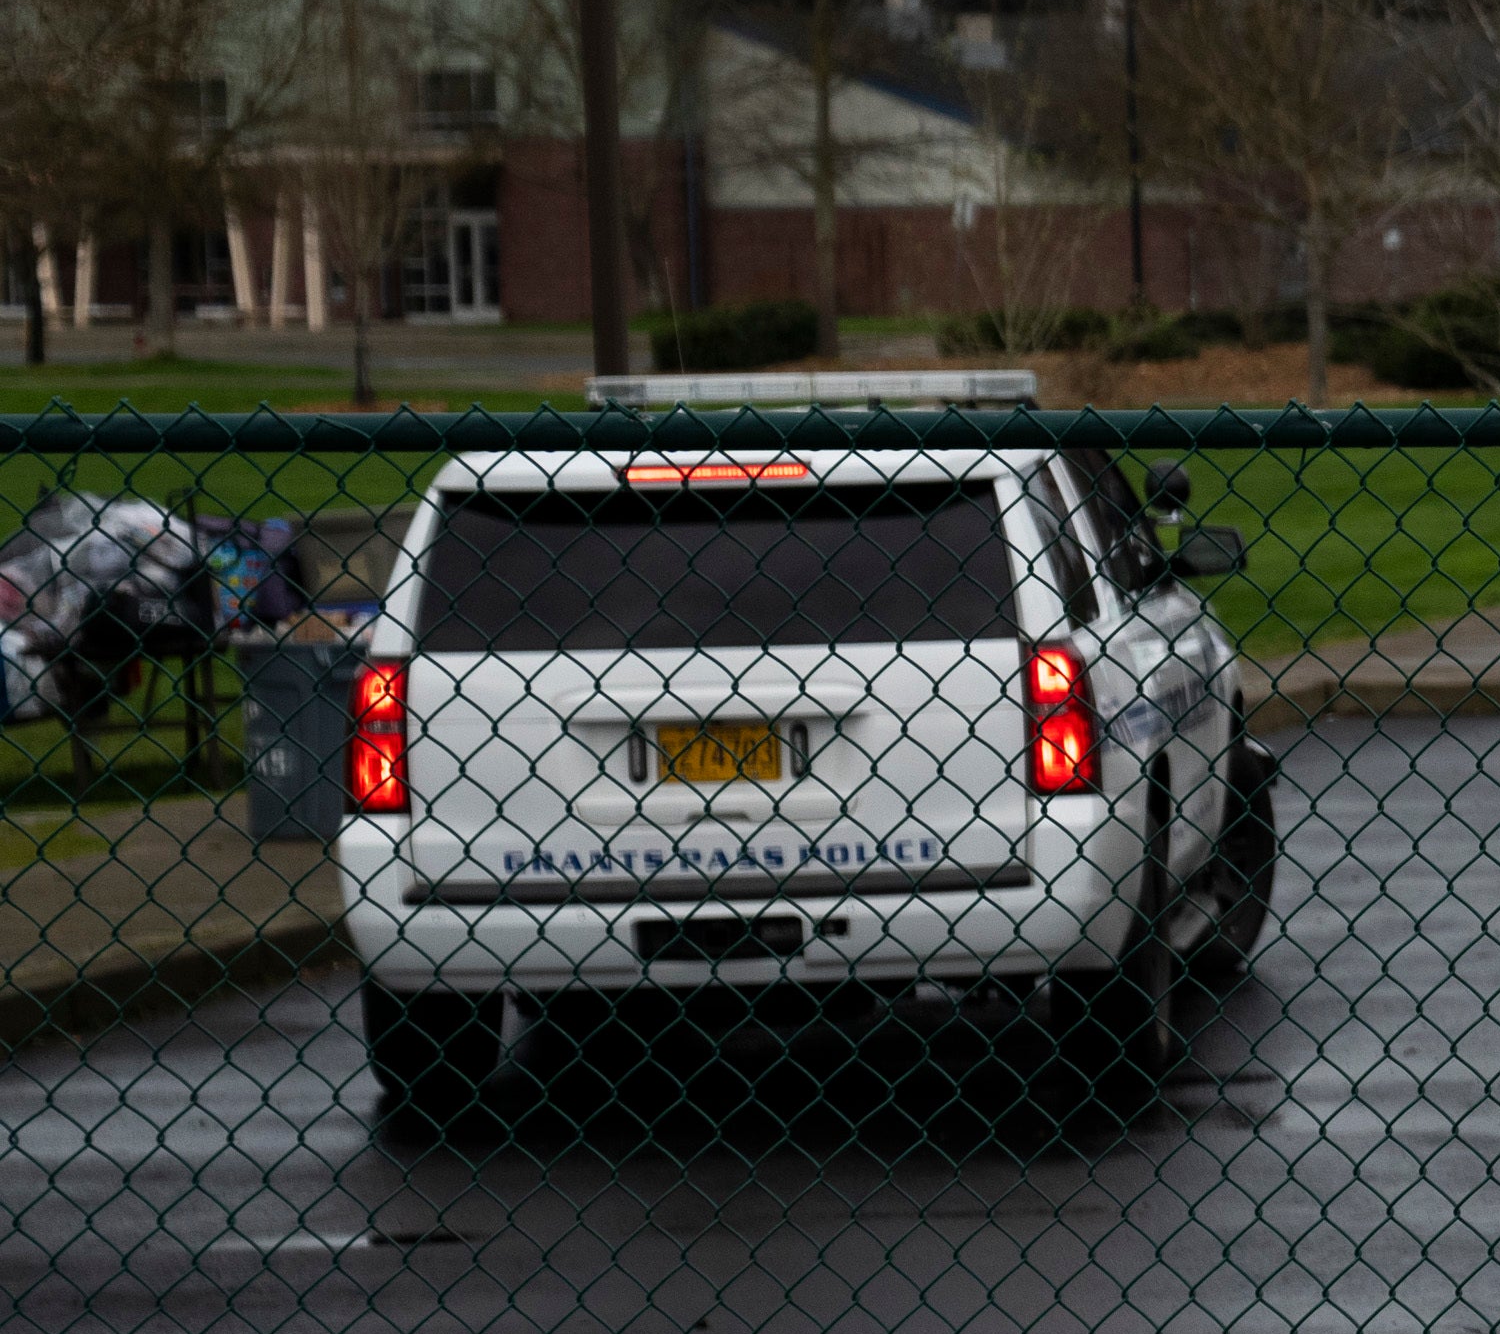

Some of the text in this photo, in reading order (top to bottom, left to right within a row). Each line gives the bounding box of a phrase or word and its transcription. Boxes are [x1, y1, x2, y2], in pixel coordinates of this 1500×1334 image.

[503, 838, 938, 875] GRANTS PASS POLICE
